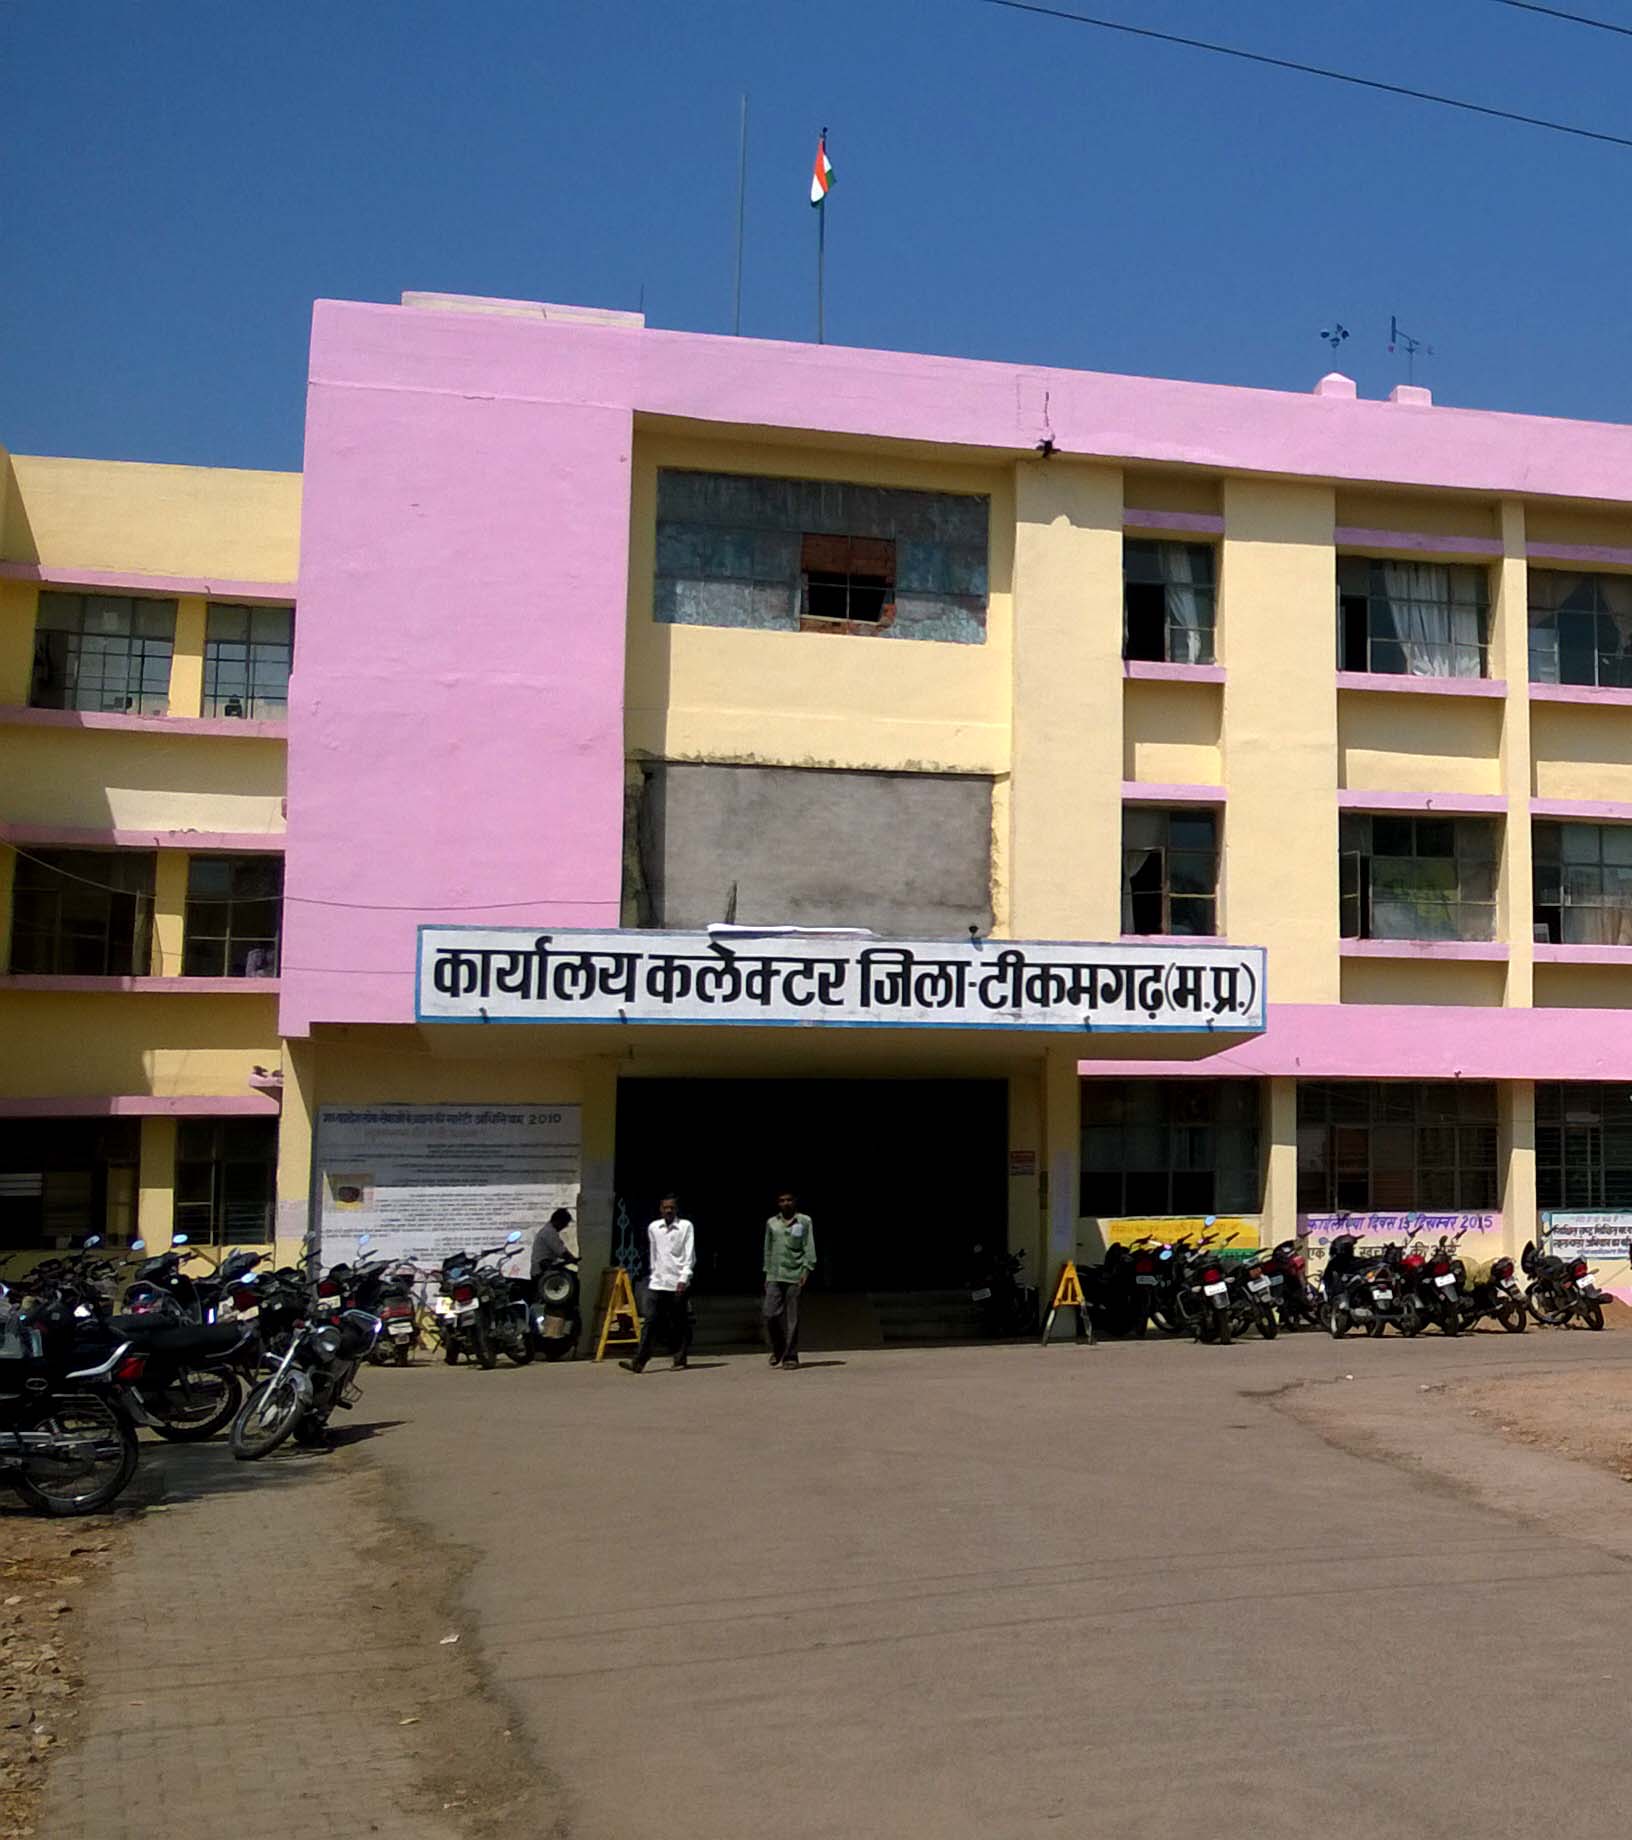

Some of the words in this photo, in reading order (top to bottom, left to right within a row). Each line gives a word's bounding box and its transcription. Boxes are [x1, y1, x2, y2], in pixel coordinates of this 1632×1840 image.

[433, 936, 645, 1003] कार्यालय
[647, 942, 851, 1007] कलेक्टर
[528, 1113, 561, 1125] 2010
[1368, 1213, 1398, 1232] दिवस
[1461, 1215, 1493, 1230] 2015
